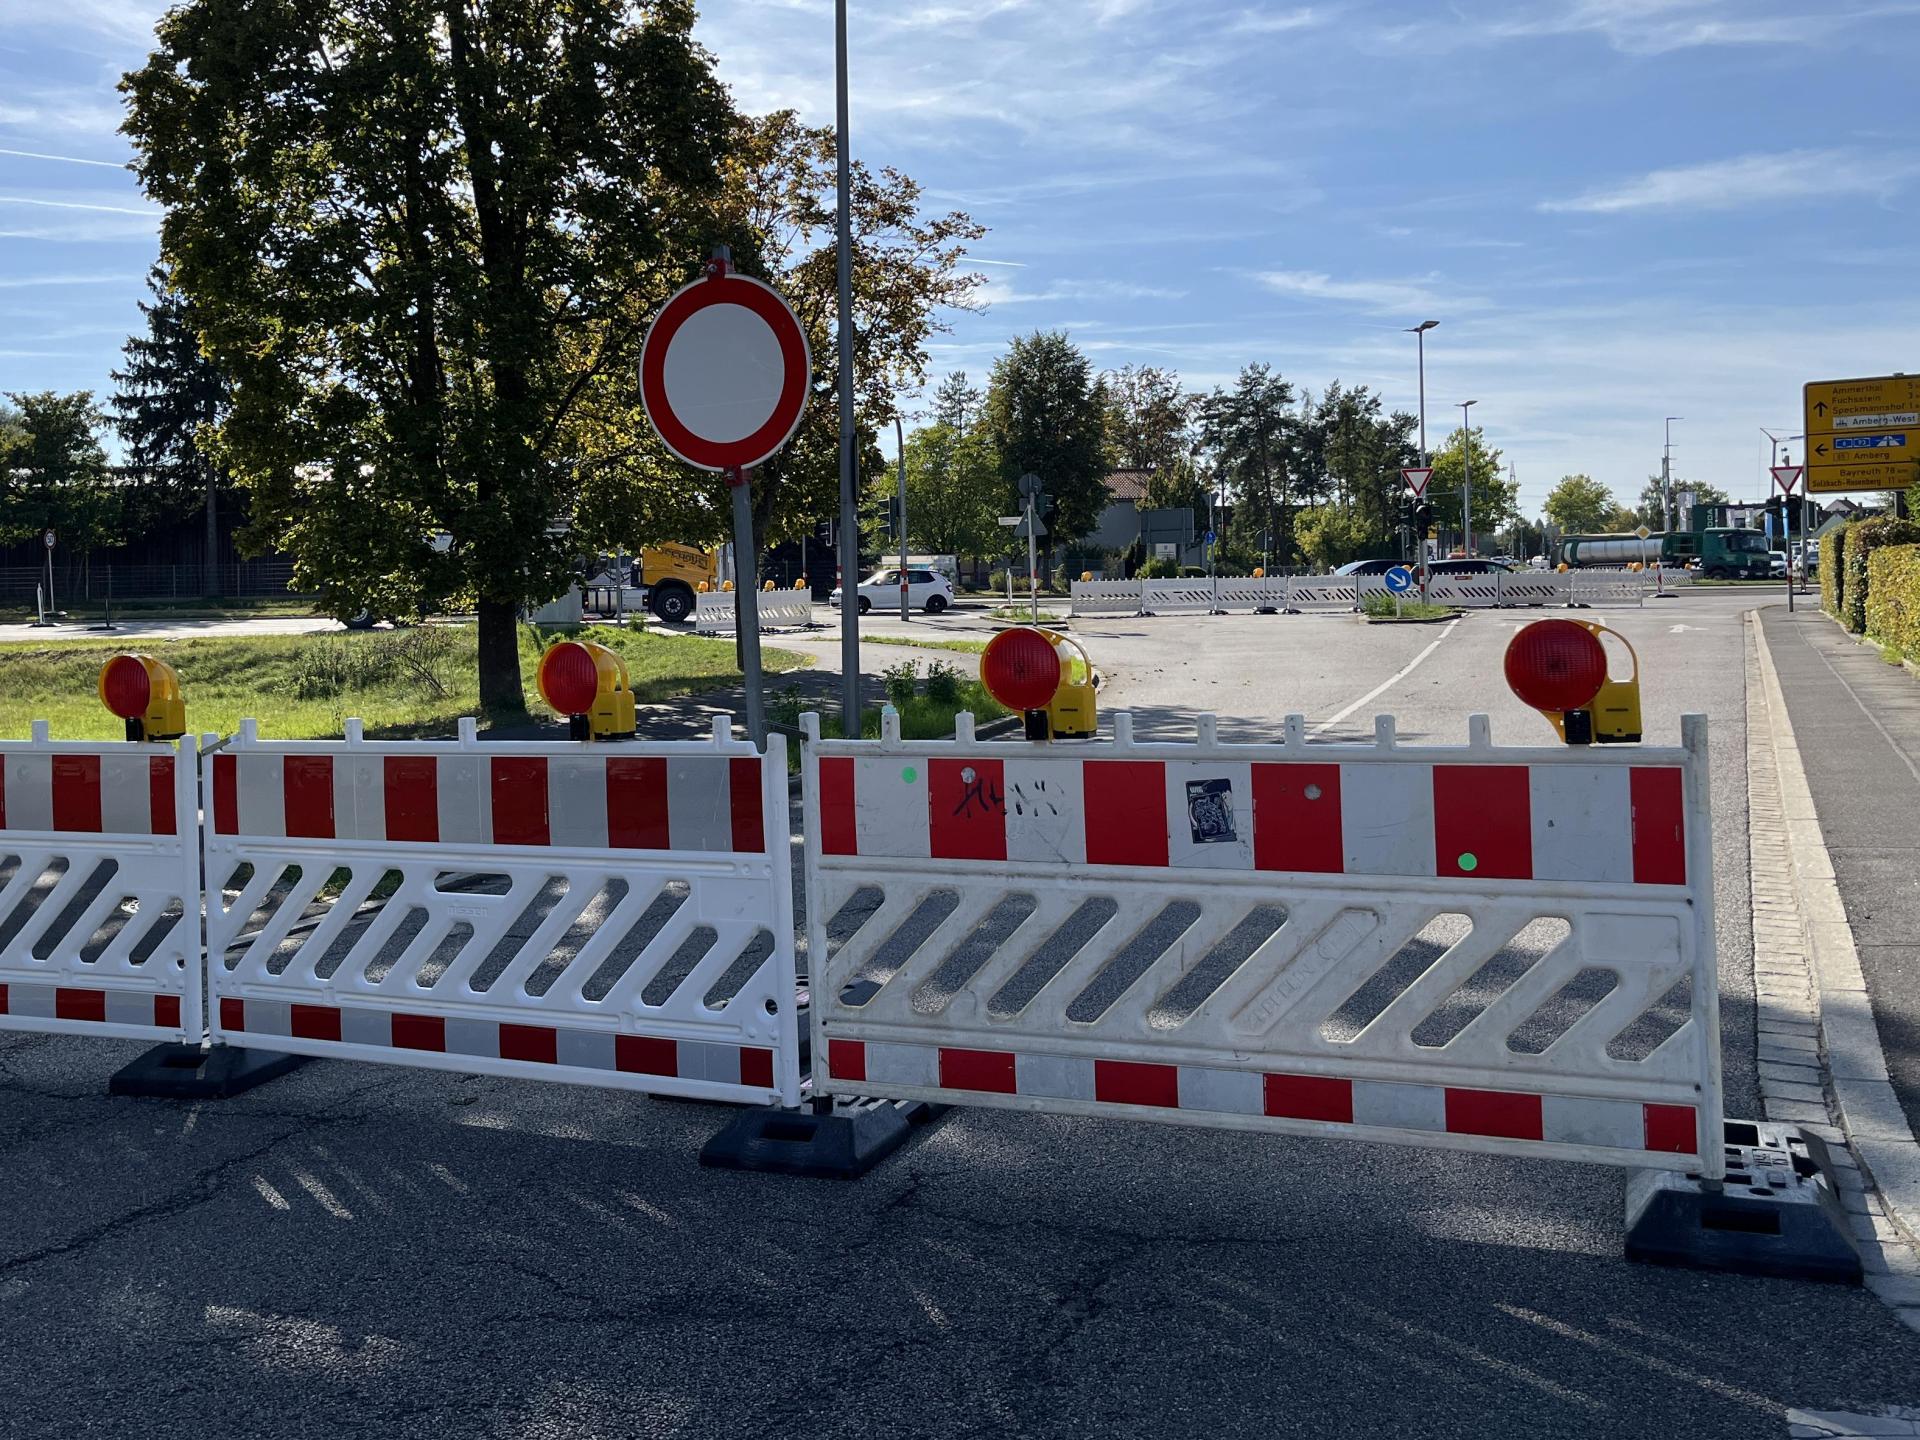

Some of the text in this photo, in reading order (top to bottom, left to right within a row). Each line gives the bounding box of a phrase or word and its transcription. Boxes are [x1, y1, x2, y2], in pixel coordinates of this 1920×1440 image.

[1832, 384, 1882, 394] Ammerthal
[1832, 395, 1880, 404] Fuchsstein
[1832, 402, 1904, 414] Speckmannshof
[1852, 414, 1916, 426] Amberg-West
[1854, 452, 1890, 462] Amberg
[1840, 468, 1881, 476] Bayreuth
